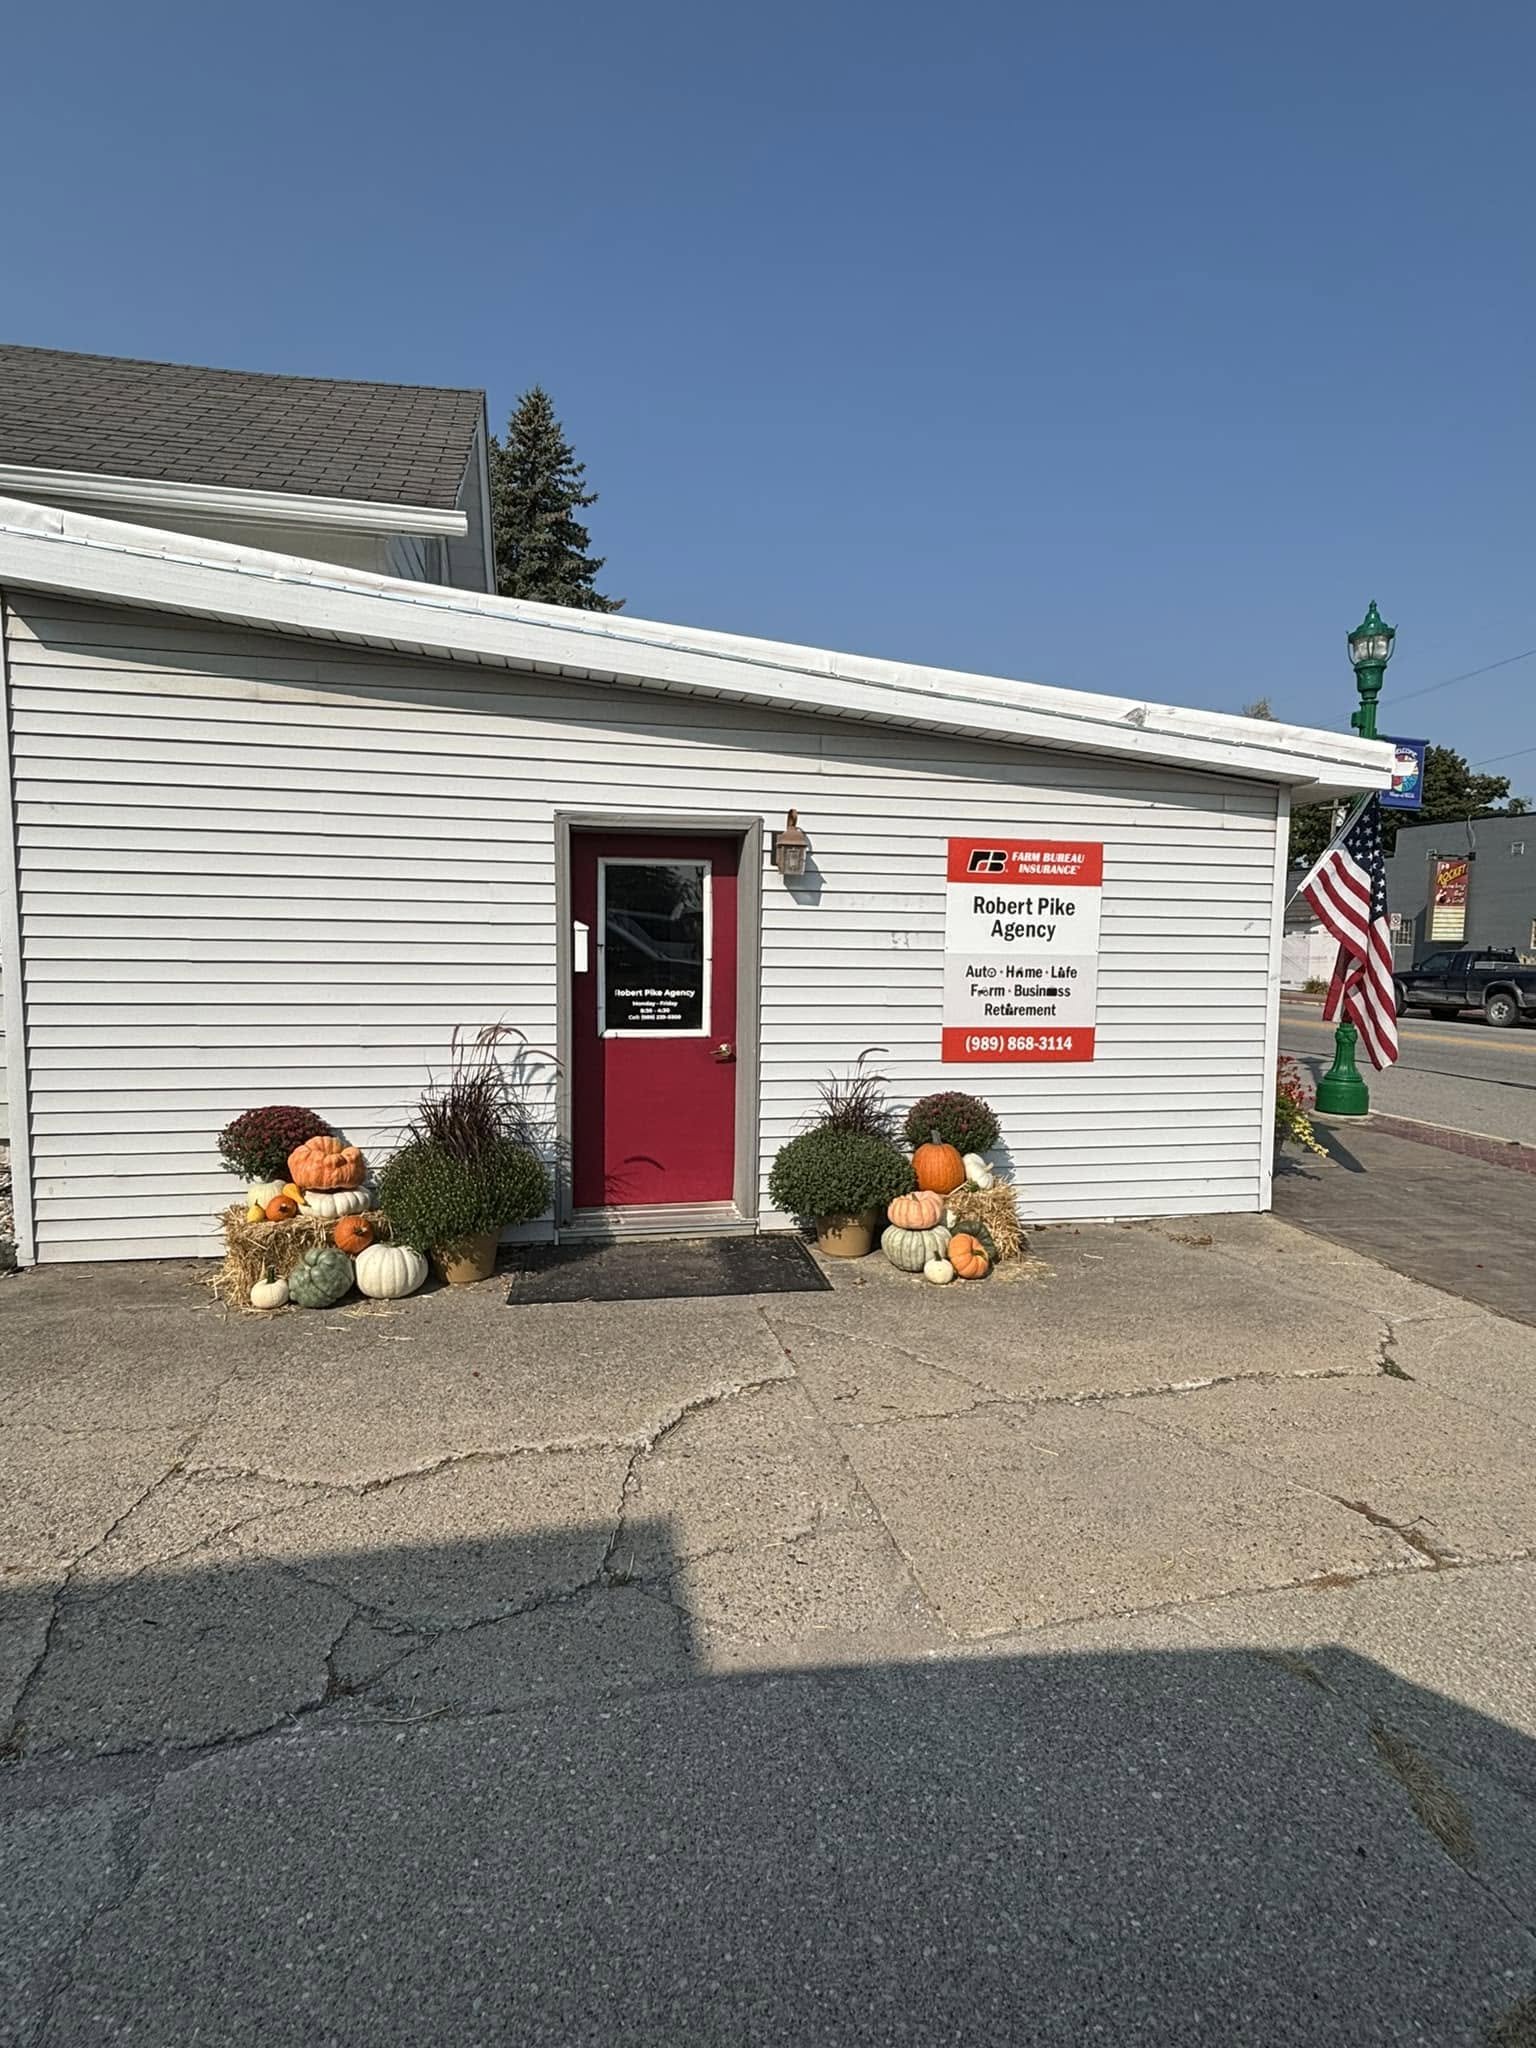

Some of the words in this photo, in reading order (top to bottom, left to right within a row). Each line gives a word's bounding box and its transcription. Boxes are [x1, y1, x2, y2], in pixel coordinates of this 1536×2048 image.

[1011, 851, 1041, 863] FARM
[1042, 852, 1085, 864] BUREAU
[1018, 864, 1080, 875] INSURANCE
[973, 895, 1033, 915] Robert
[1038, 897, 1076, 917] Pike
[991, 919, 1057, 943] Agency
[1005, 965, 1043, 979] Hme
[644, 989, 663, 997] Pike
[664, 989, 696, 998] Agency
[970, 983, 1005, 997] Frm
[1014, 984, 1071, 998] Businss
[965, 1035, 1005, 1053] (989)
[1007, 1036, 1073, 1051] 868-3114
